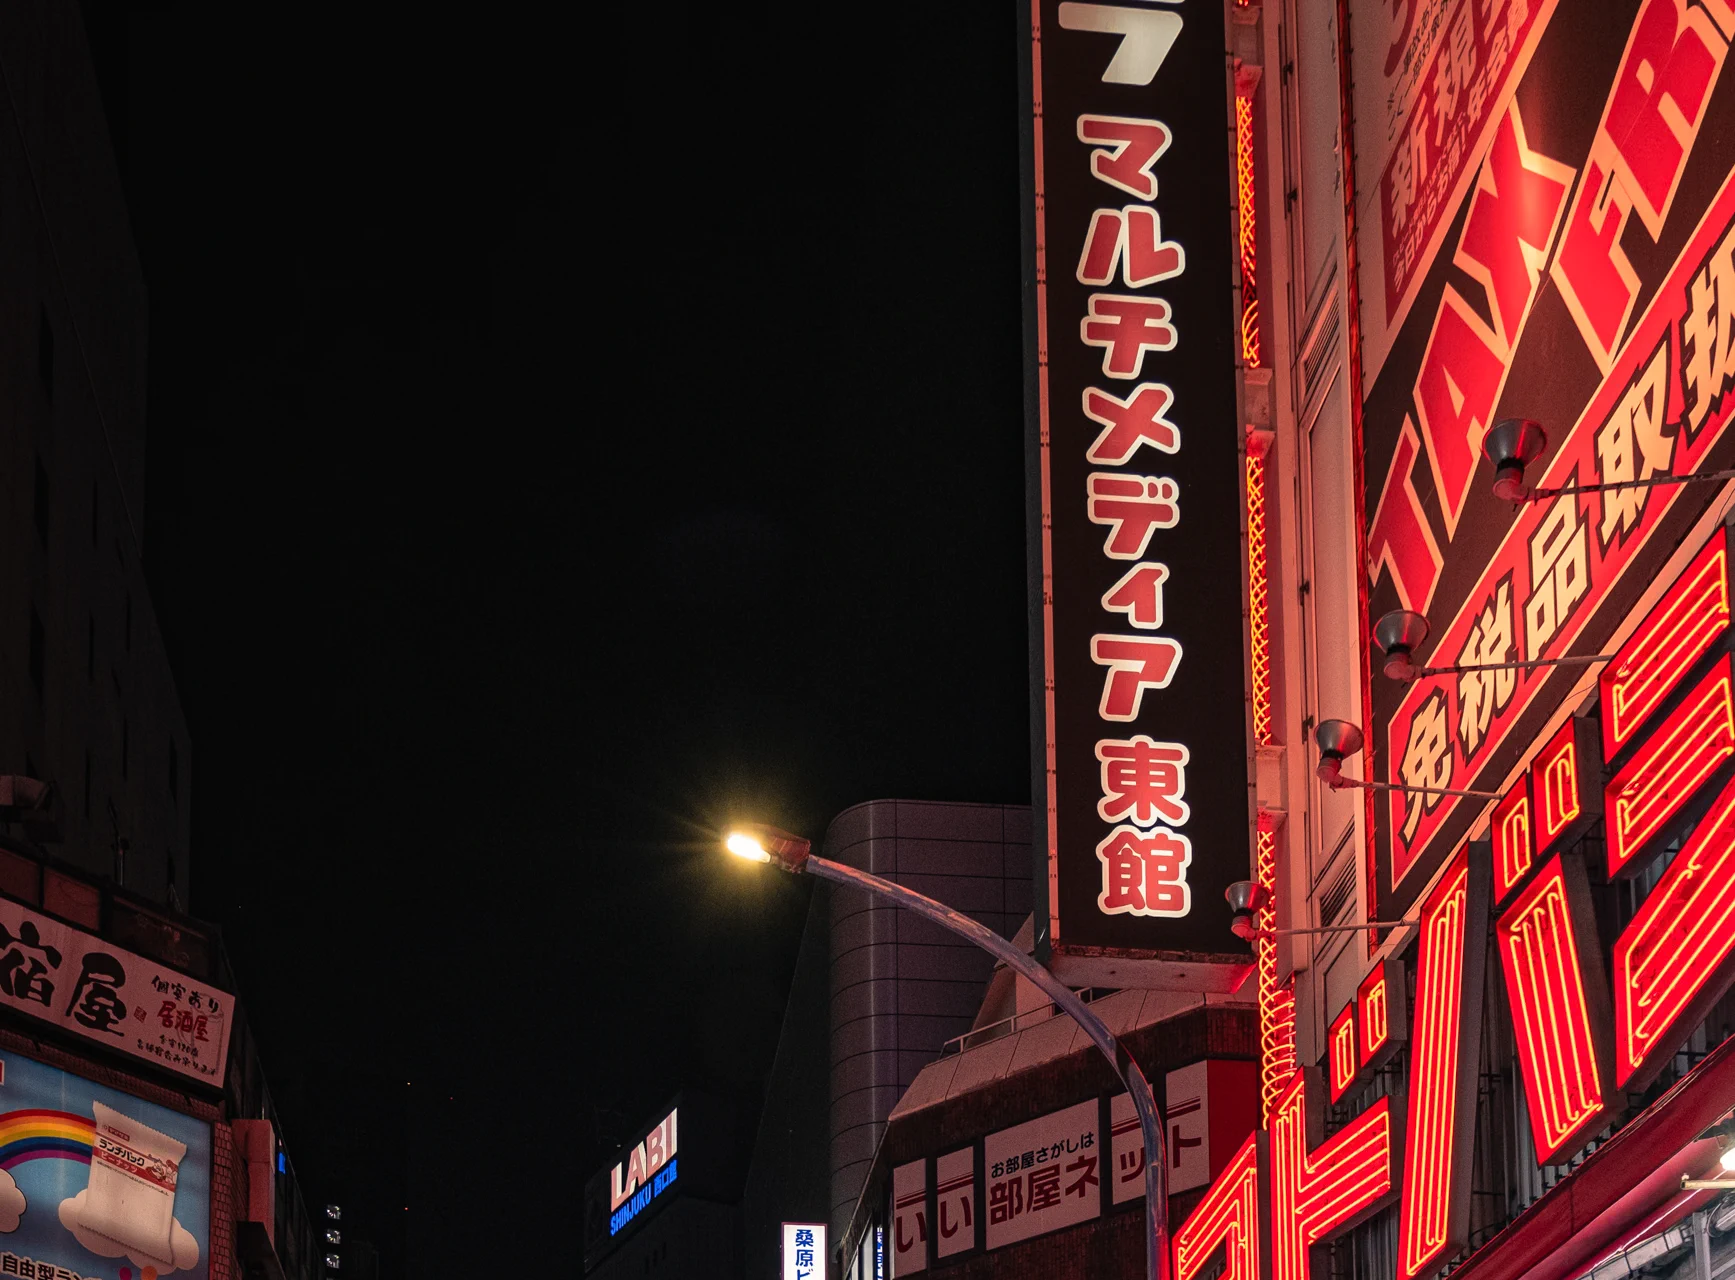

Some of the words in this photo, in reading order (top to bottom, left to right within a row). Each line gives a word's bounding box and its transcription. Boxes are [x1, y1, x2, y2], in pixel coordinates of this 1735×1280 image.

[1368, 93, 1577, 614] TAX
[1549, 0, 1735, 382] FR
[1076, 113, 1192, 918] マルチメディア東館
[151, 974, 219, 1014] 個室あり
[157, 1000, 210, 1042] 居酒屋
[99, 1138, 145, 1167] ランチパック
[611, 1107, 677, 1213] LABI
[991, 1131, 1095, 1180] お部屋さがしは
[610, 1182, 651, 1237] SHINJUKU
